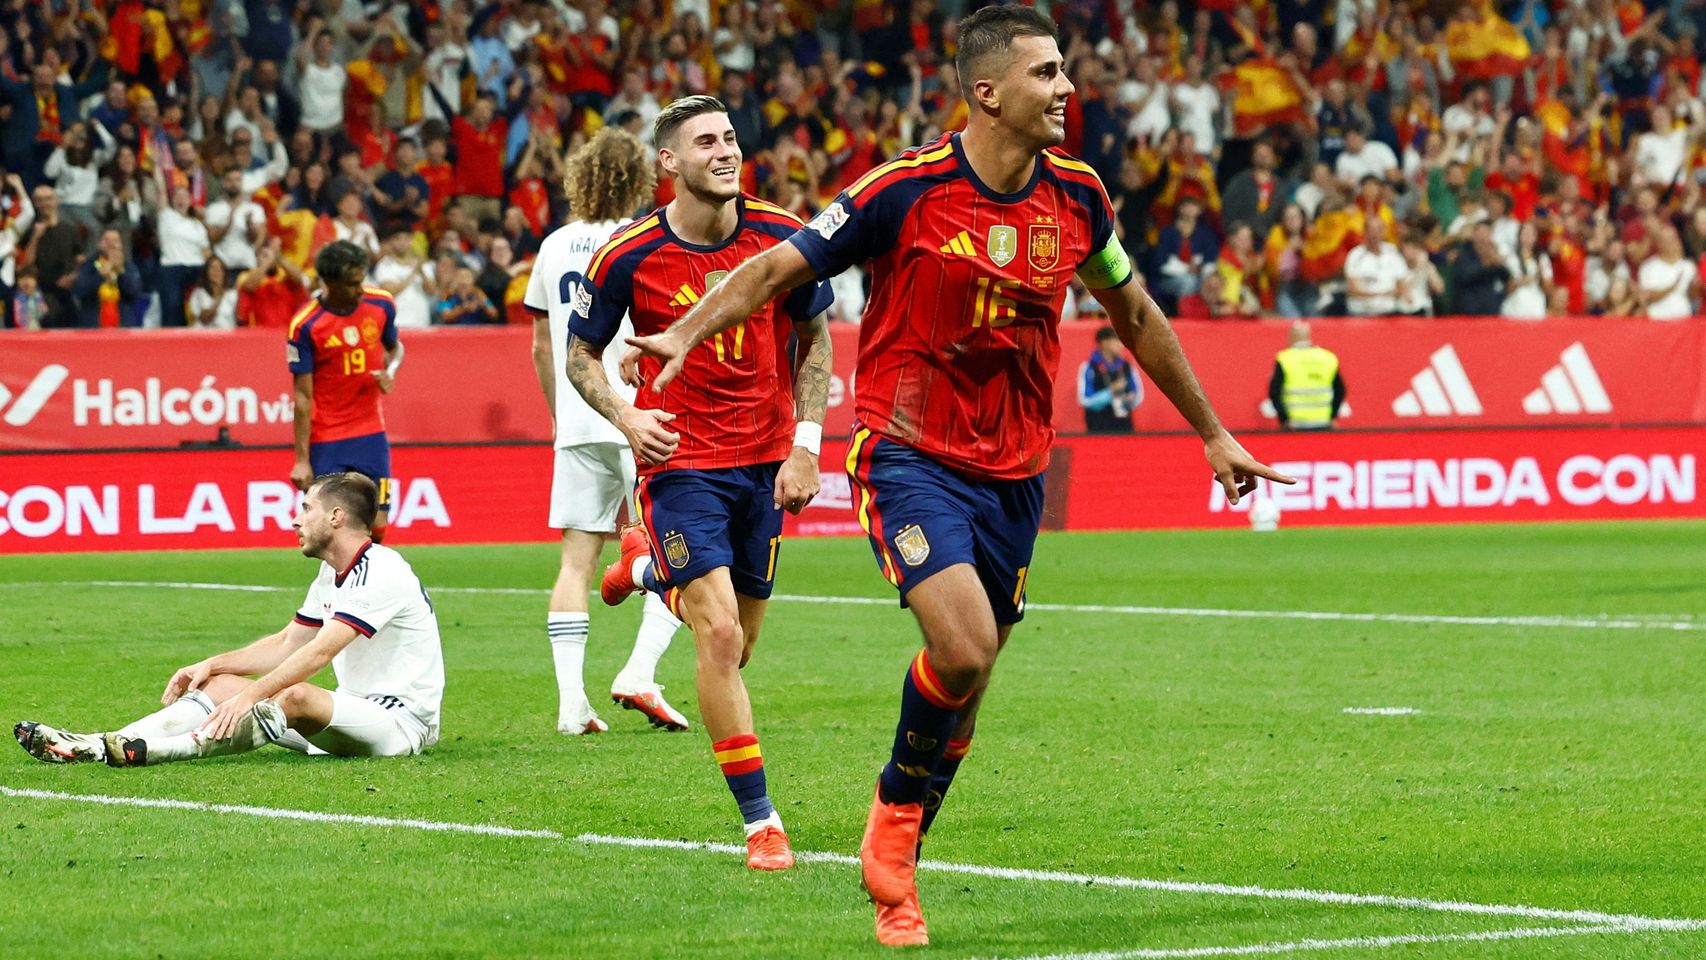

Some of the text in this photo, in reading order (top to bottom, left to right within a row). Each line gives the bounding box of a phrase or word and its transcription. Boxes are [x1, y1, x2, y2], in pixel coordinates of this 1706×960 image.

[972, 277, 1021, 328] 16
[343, 348, 366, 375] 19
[73, 375, 258, 426] Halcón
[1556, 453, 1696, 506] CON
[0, 476, 452, 537] ON LA RA
[766, 534, 782, 582] 1
